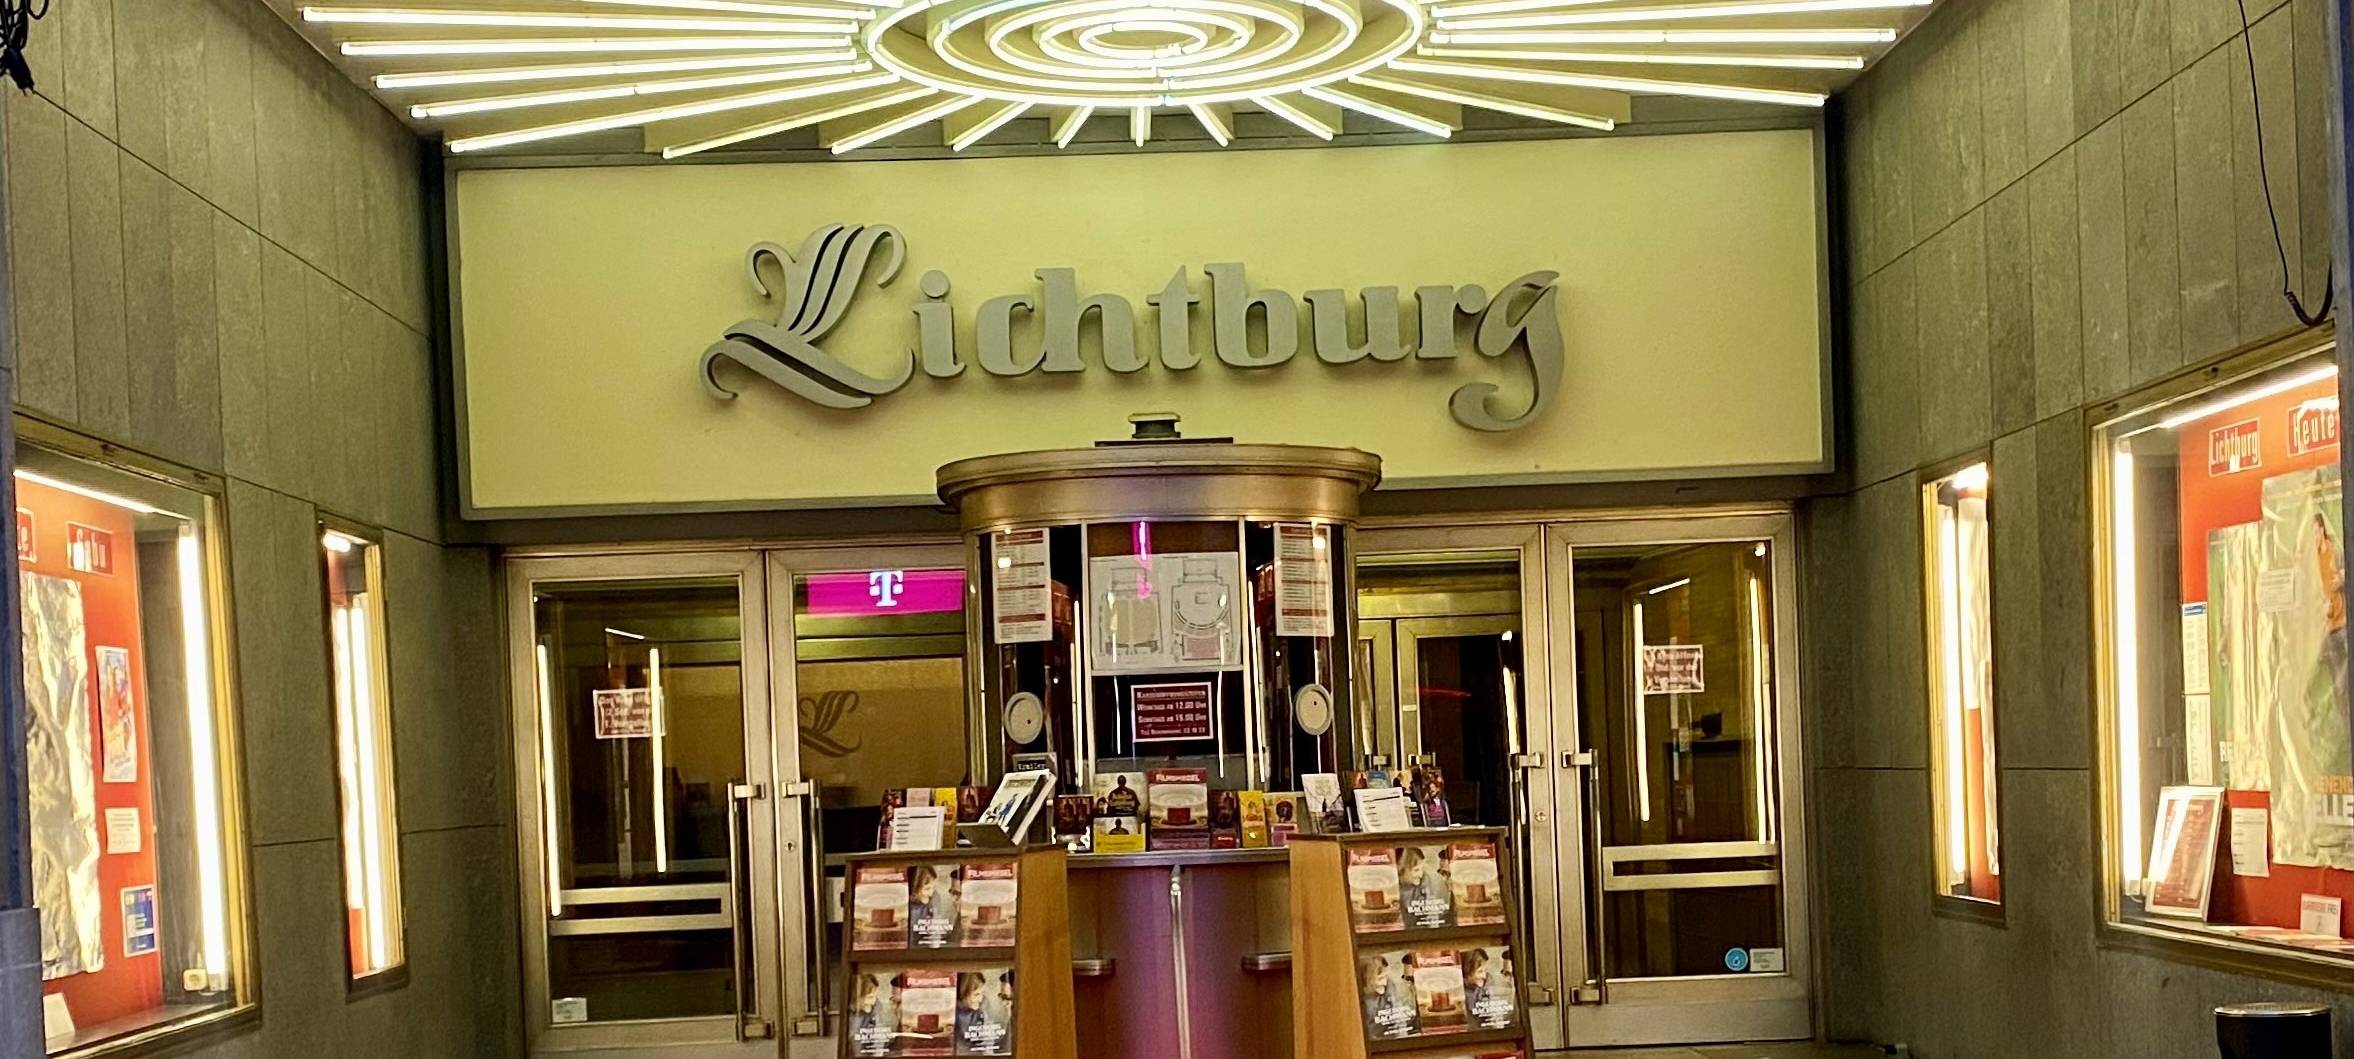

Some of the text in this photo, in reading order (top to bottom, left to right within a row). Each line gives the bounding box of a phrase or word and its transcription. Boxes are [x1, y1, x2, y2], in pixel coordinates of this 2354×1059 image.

[700, 224, 1565, 432] Lichtburg
[2210, 425, 2259, 466] Lichtburg
[2292, 407, 2335, 453] Heute
[869, 570, 903, 607] T
